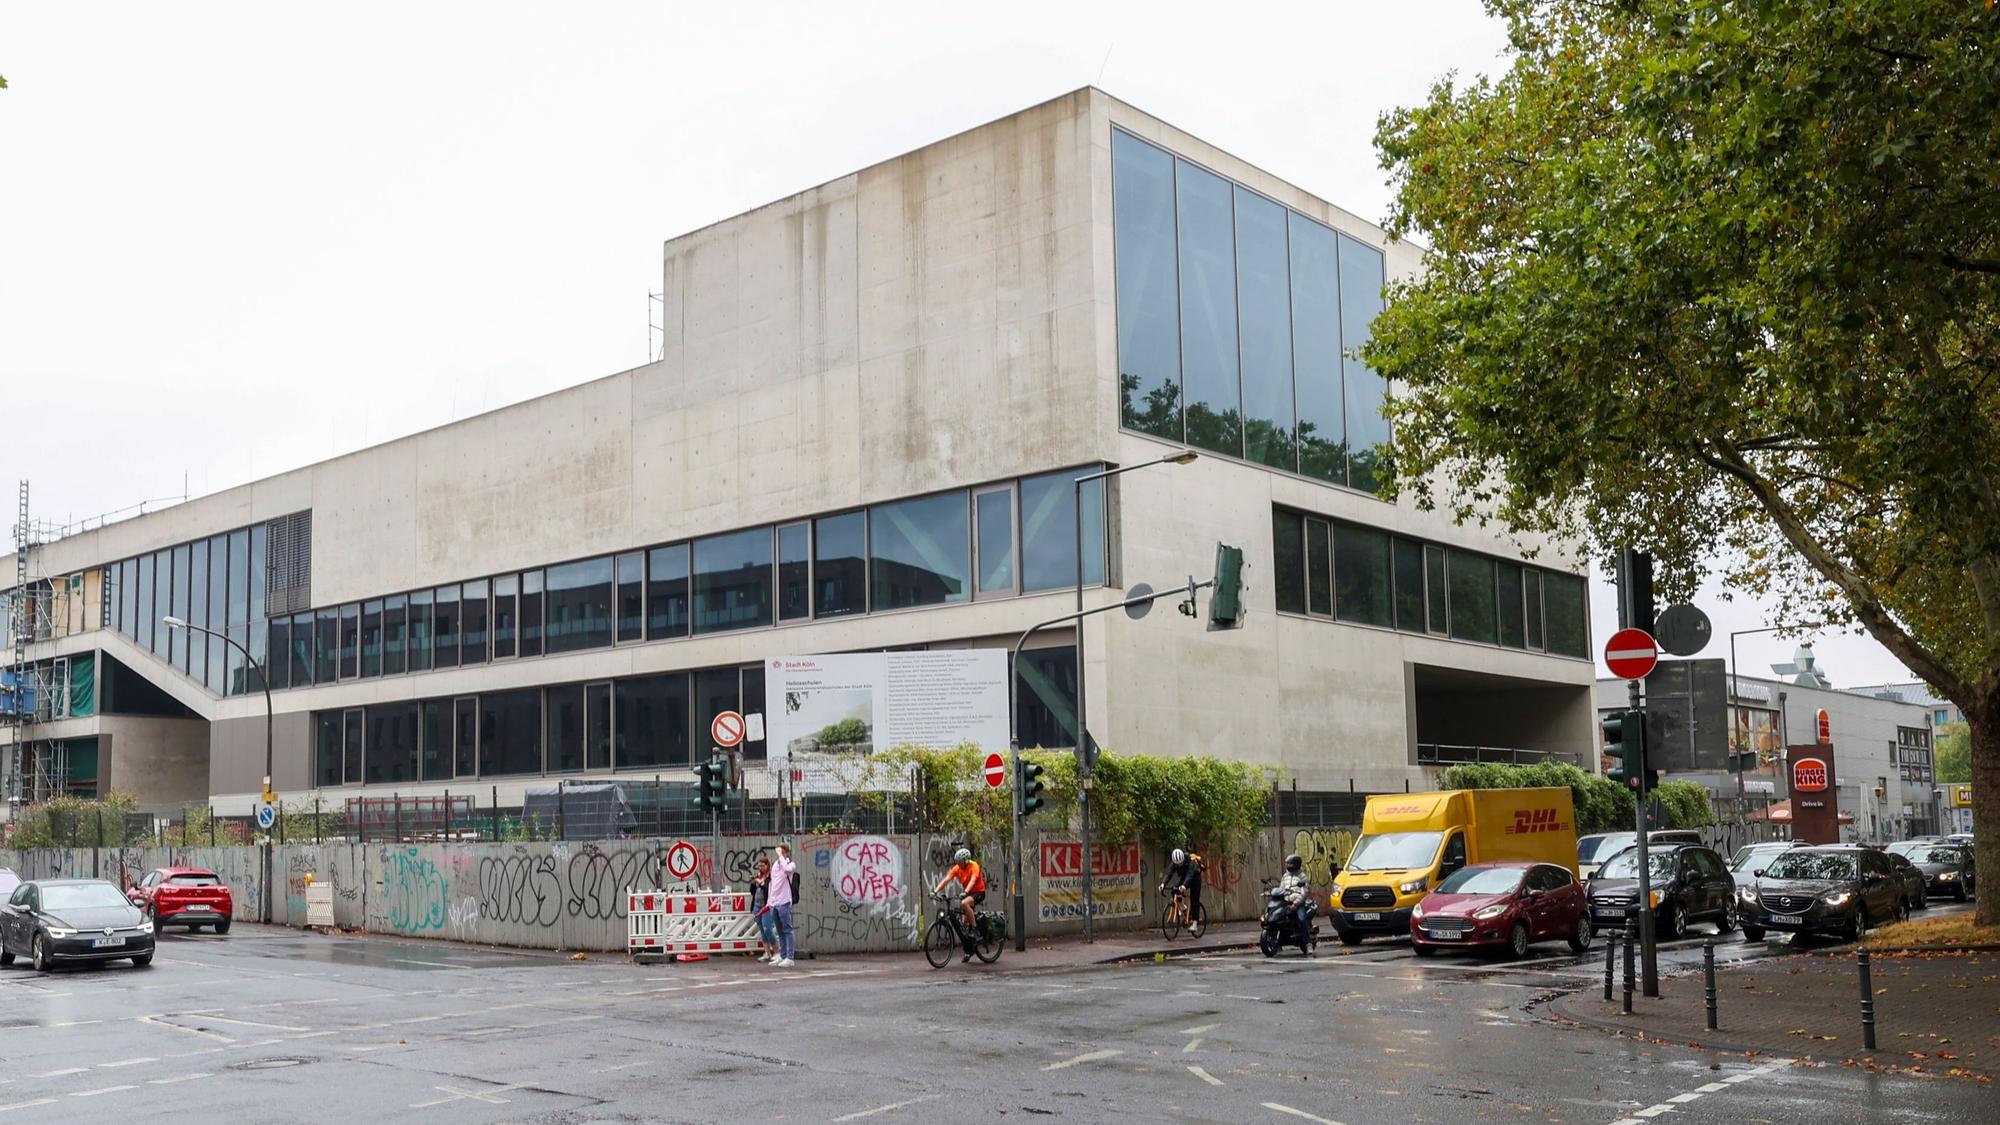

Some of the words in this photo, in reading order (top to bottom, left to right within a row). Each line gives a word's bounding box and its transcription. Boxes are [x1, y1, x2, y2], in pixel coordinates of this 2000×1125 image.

[1795, 768, 1825, 777] BURGER
[1795, 775, 1826, 786] KING
[1384, 805, 1421, 815] DHL
[1514, 808, 1561, 834] DHL
[844, 842, 891, 865] CAR
[862, 864, 878, 879] IS
[840, 873, 900, 901] OVER
[1047, 876, 1135, 890] www.klit-gruppe.de
